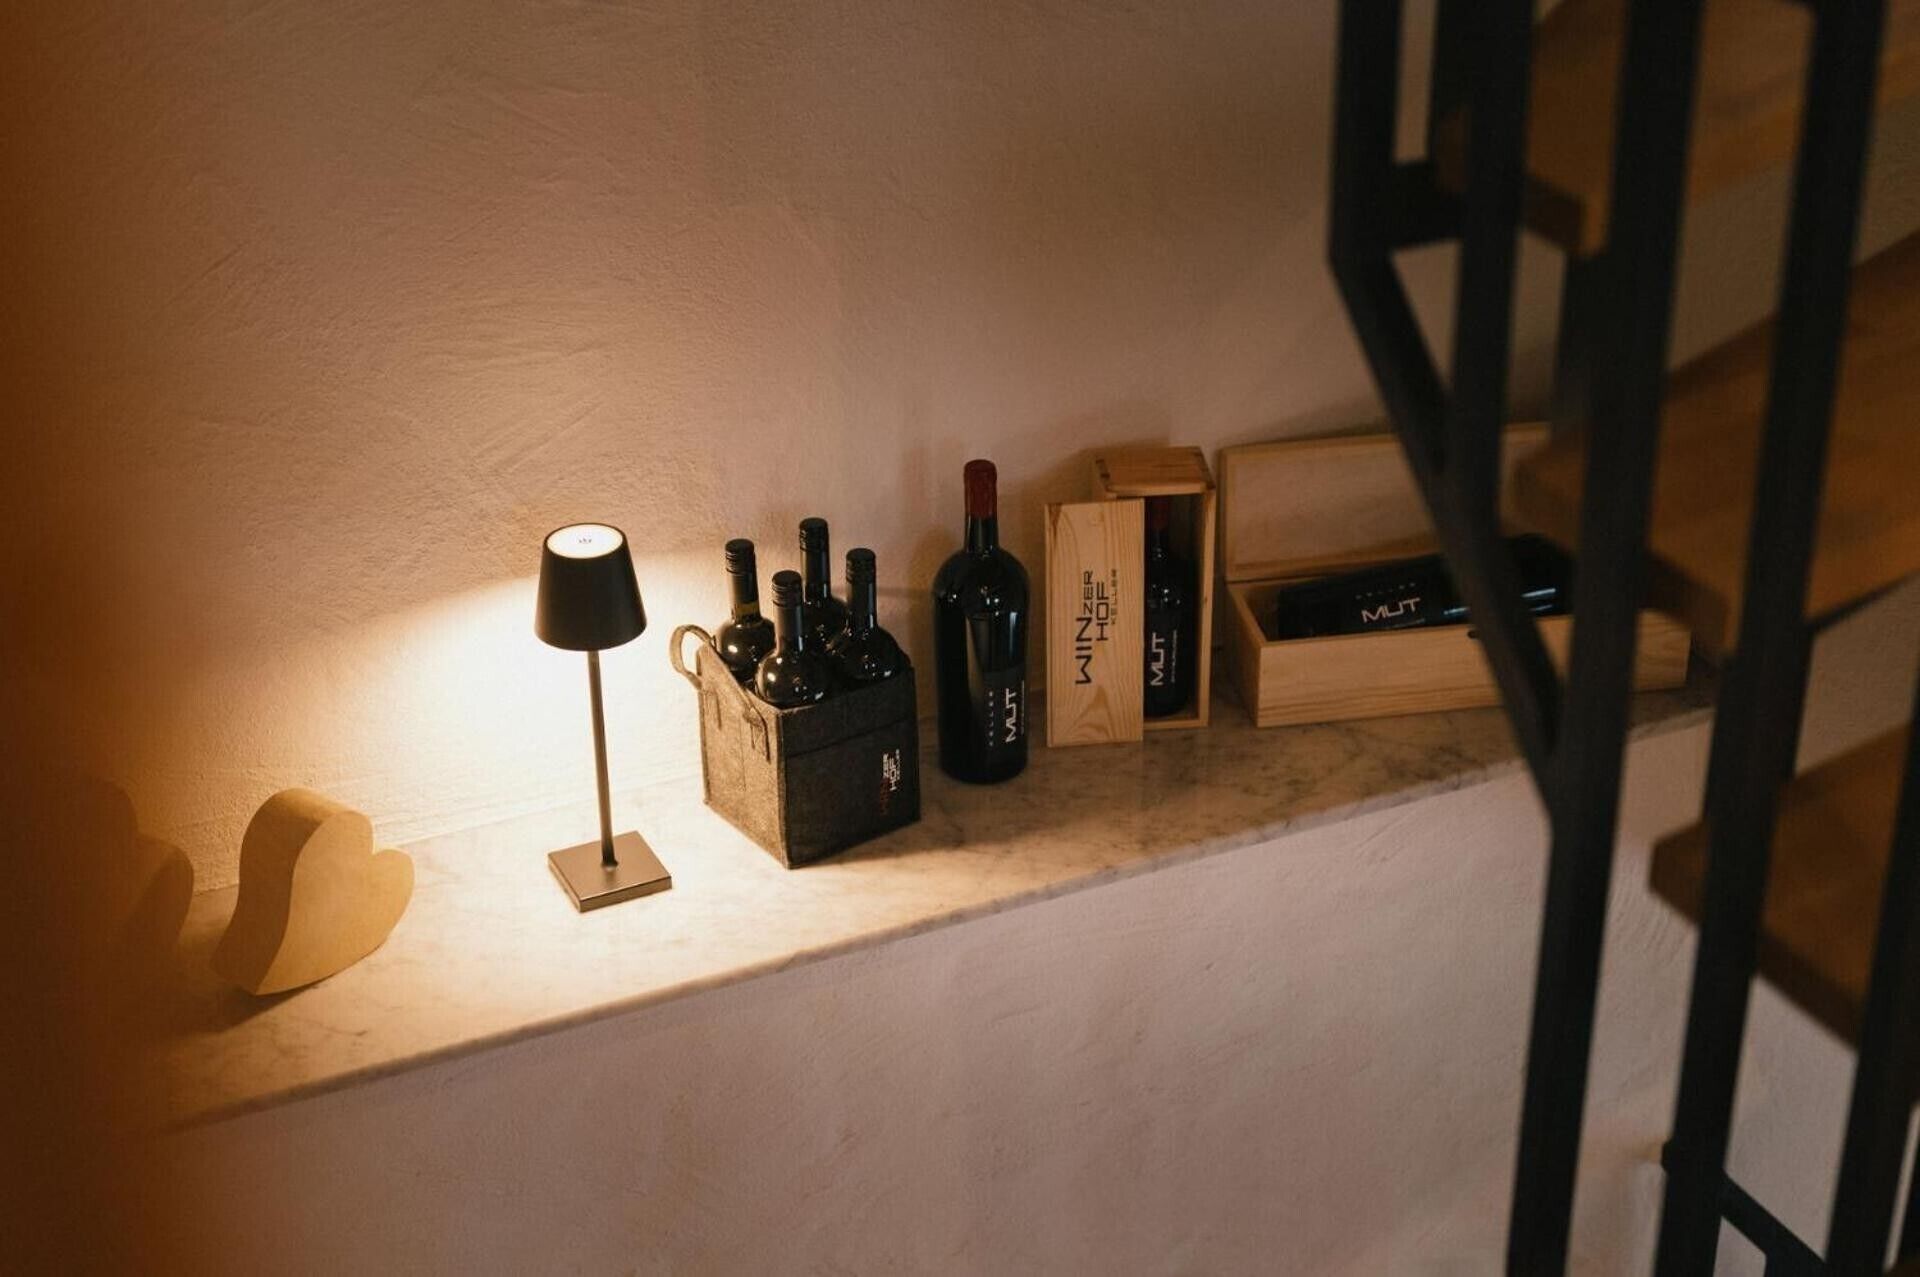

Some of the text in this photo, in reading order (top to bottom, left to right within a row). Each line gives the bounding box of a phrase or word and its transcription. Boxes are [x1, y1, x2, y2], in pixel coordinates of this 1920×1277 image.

[1075, 571, 1093, 684] WINZER
[1096, 582, 1109, 641] HOF
[1361, 597, 1421, 623] MUT
[1150, 632, 1165, 685] MUT
[1005, 688, 1017, 742] MUT
[889, 758, 897, 791] HOF
